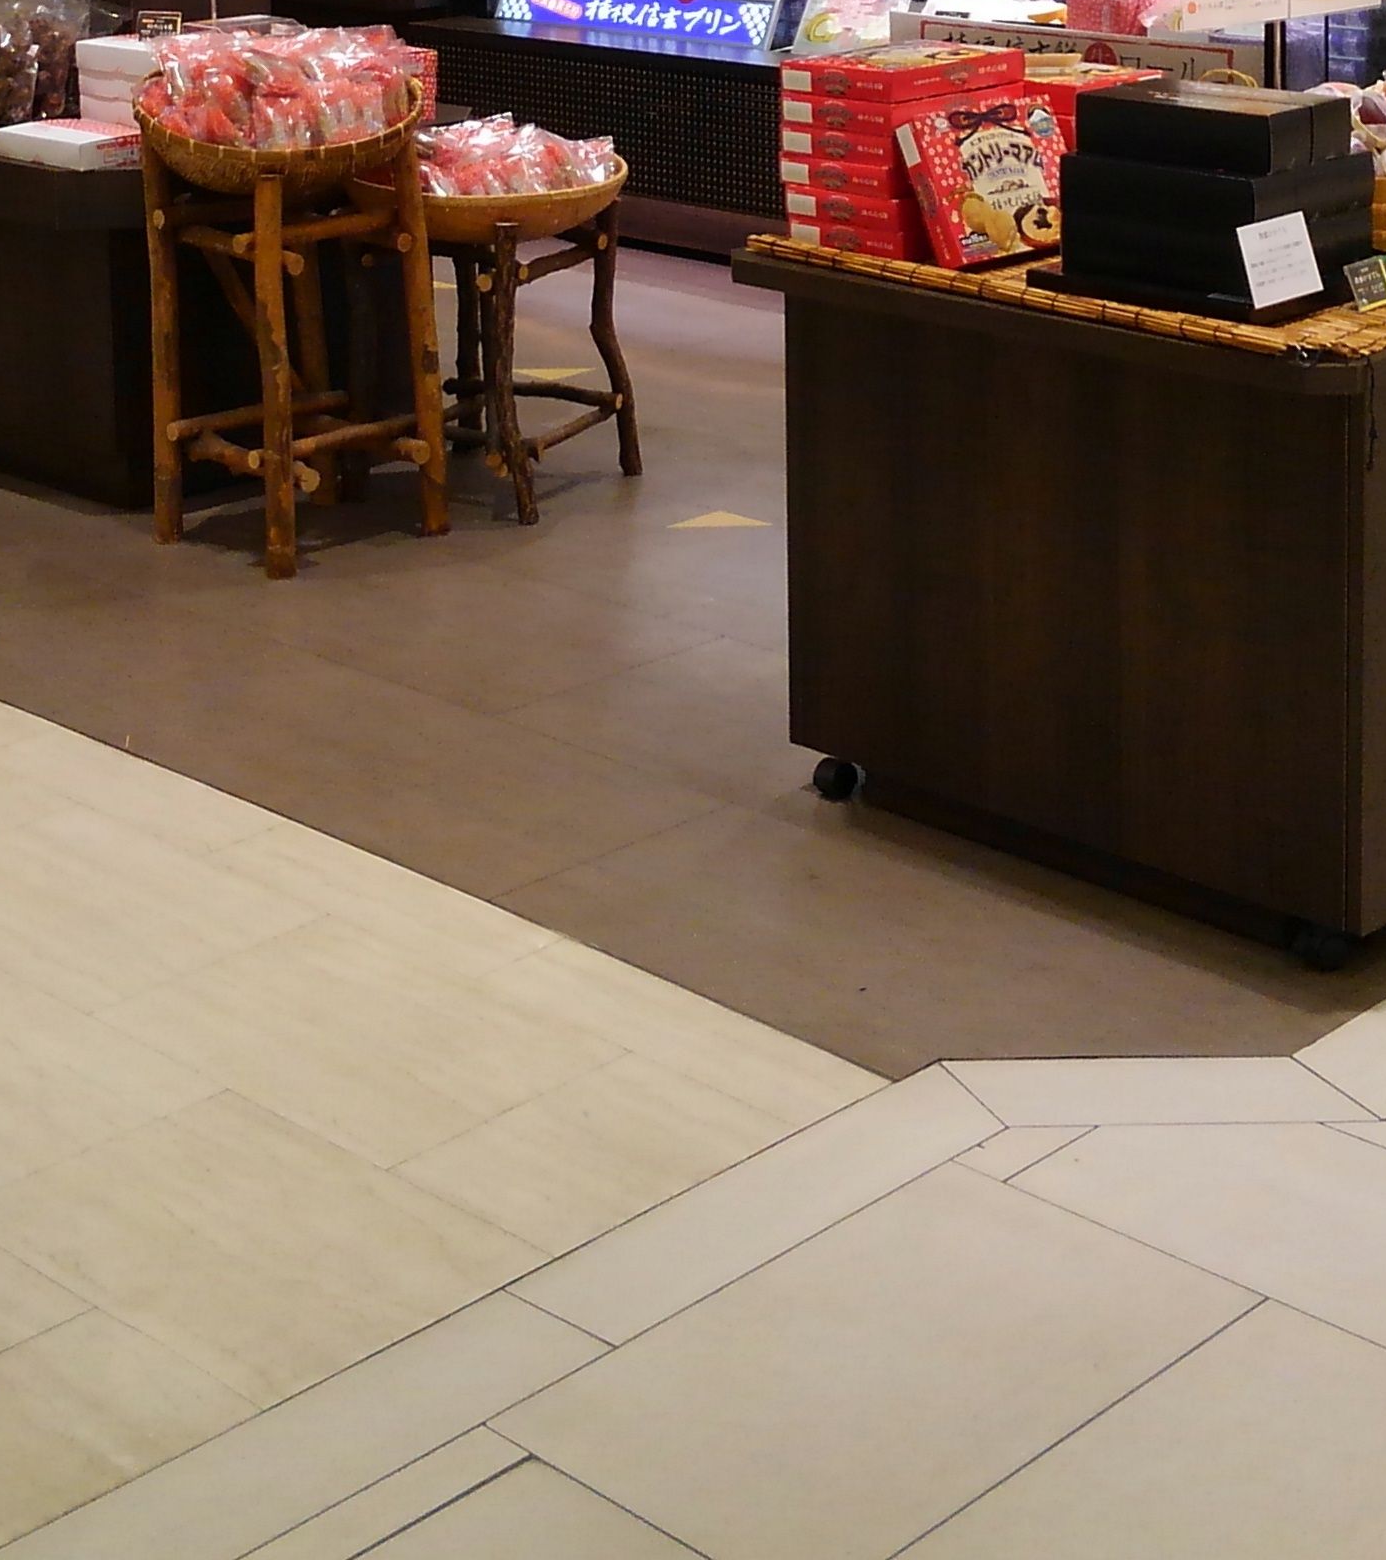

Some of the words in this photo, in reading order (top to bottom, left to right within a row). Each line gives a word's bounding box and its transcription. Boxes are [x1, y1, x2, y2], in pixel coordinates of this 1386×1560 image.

[962, 141, 1045, 181] カントリーマアム
